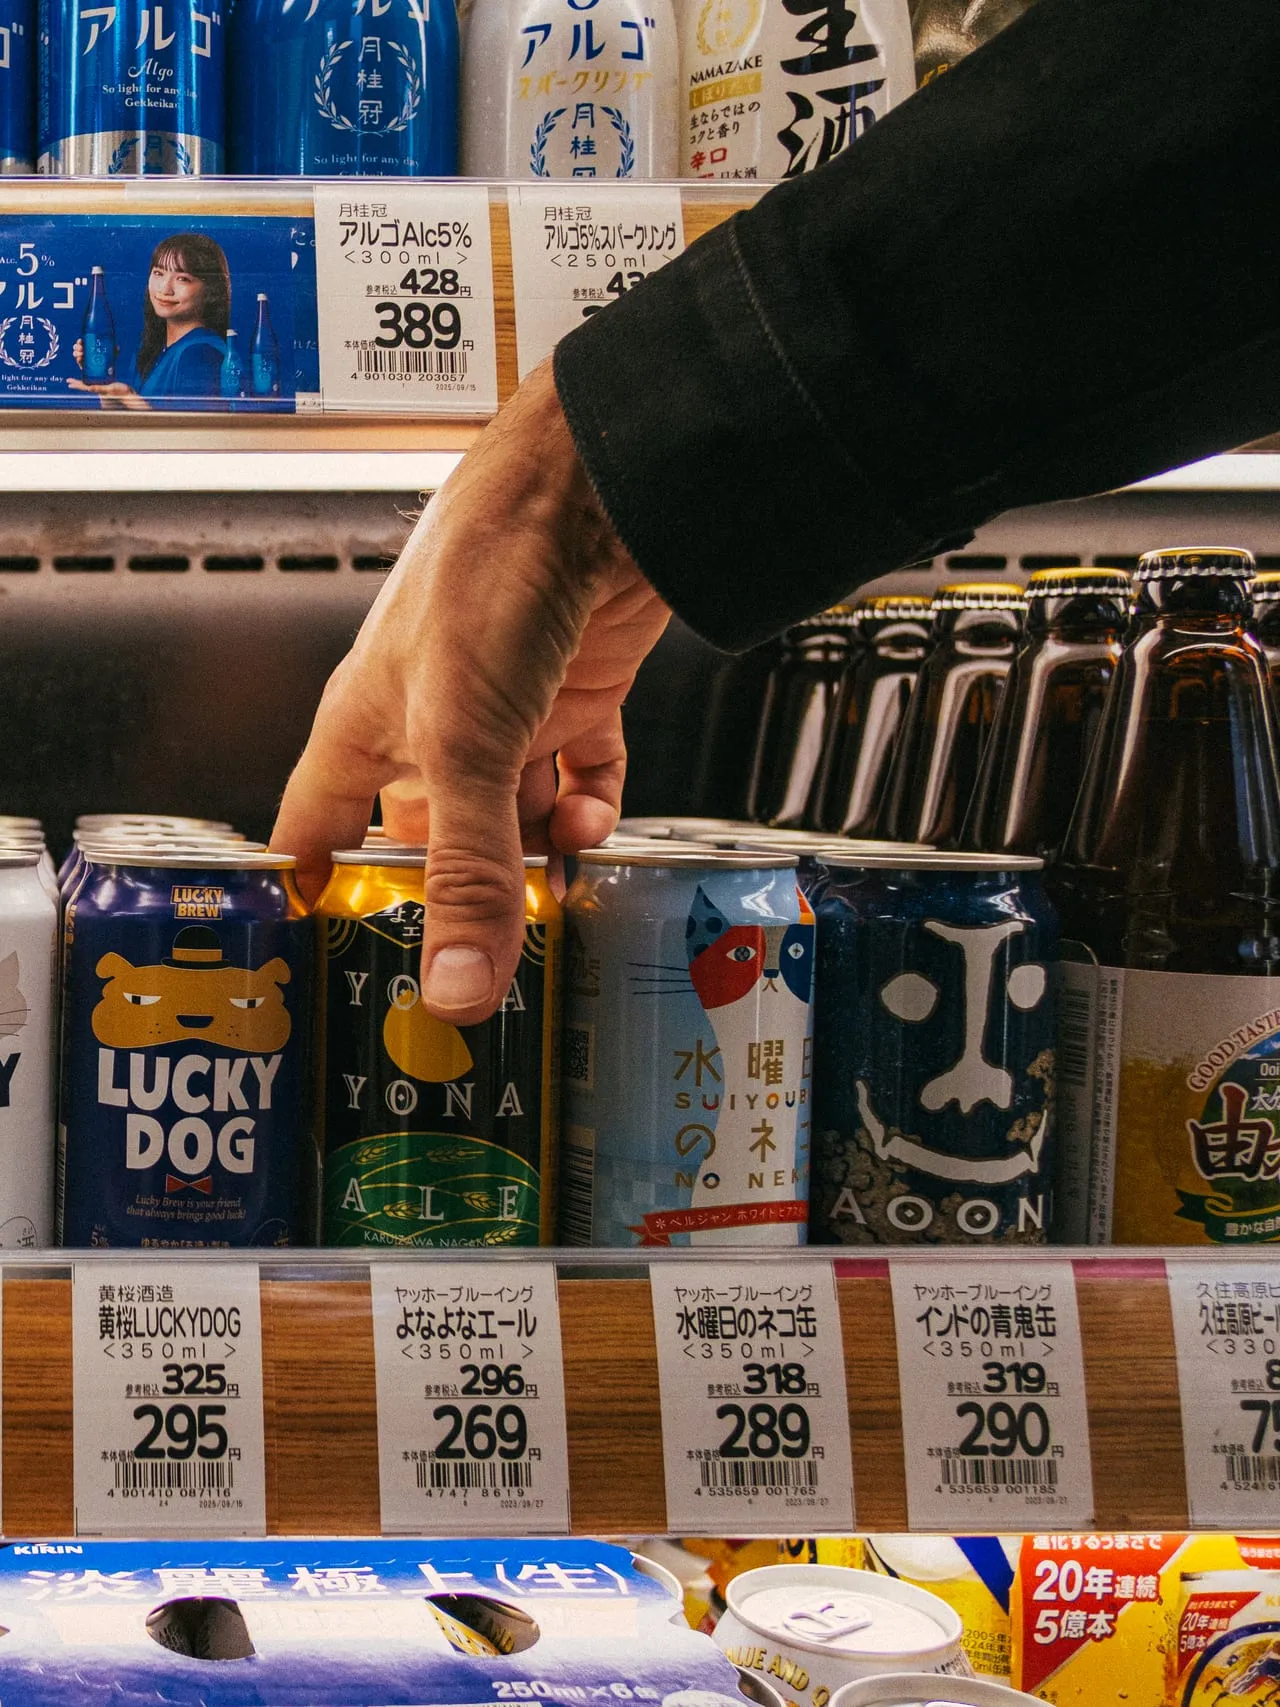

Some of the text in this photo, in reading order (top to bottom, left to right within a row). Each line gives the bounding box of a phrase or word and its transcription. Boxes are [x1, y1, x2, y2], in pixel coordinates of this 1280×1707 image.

[80, 6, 221, 58] アルゴ
[521, 18, 656, 69] アルゴ
[128, 58, 173, 81] Algo
[356, 35, 384, 125] 月桂冠
[690, 55, 763, 85] NAMAZAKE
[690, 101, 761, 130] 生ならではの
[690, 121, 740, 144] コクと香り
[691, 147, 727, 170] 辛口
[339, 203, 387, 217] 月桂冠
[544, 206, 592, 221] 月桂冠
[339, 219, 472, 248] アルゴAlc5%
[544, 222, 676, 250] アルゴ5%スパークリング
[19, 315, 35, 364] 月桂冠
[173, 887, 224, 903] LUCKY
[177, 903, 219, 918] BREW
[1189, 1040, 1236, 1090] GOOD
[98, 1047, 283, 1113] LUCKY
[342, 1074, 524, 1120] YONA
[126, 1113, 256, 1174] DOG
[675, 1172, 720, 1190] NO
[136, 1194, 161, 1207] Lucky
[162, 1197, 184, 1207] Brew
[341, 1178, 519, 1221] ALE
[98, 1285, 174, 1303] 黄桜酒造
[394, 1286, 533, 1303] ヤッホーブルーイング
[674, 1285, 812, 1302] ヤッホーブルーイング
[913, 1283, 1051, 1301] ヤッホーブルーイング
[98, 1304, 241, 1340] 黄桜LUCKYDOG
[396, 1306, 537, 1340] よなよなエール
[676, 1304, 817, 1340] 水曜日のネコ缶
[916, 1303, 1057, 1338] インドの青鬼缶
[14, 1544, 83, 1555] KIRIN
[1032, 1560, 1159, 1602] 20年連続
[1033, 1610, 1114, 1645] 5億本
[1180, 1635, 1207, 1652] 5億本
[766, 1655, 809, 1691] AND
